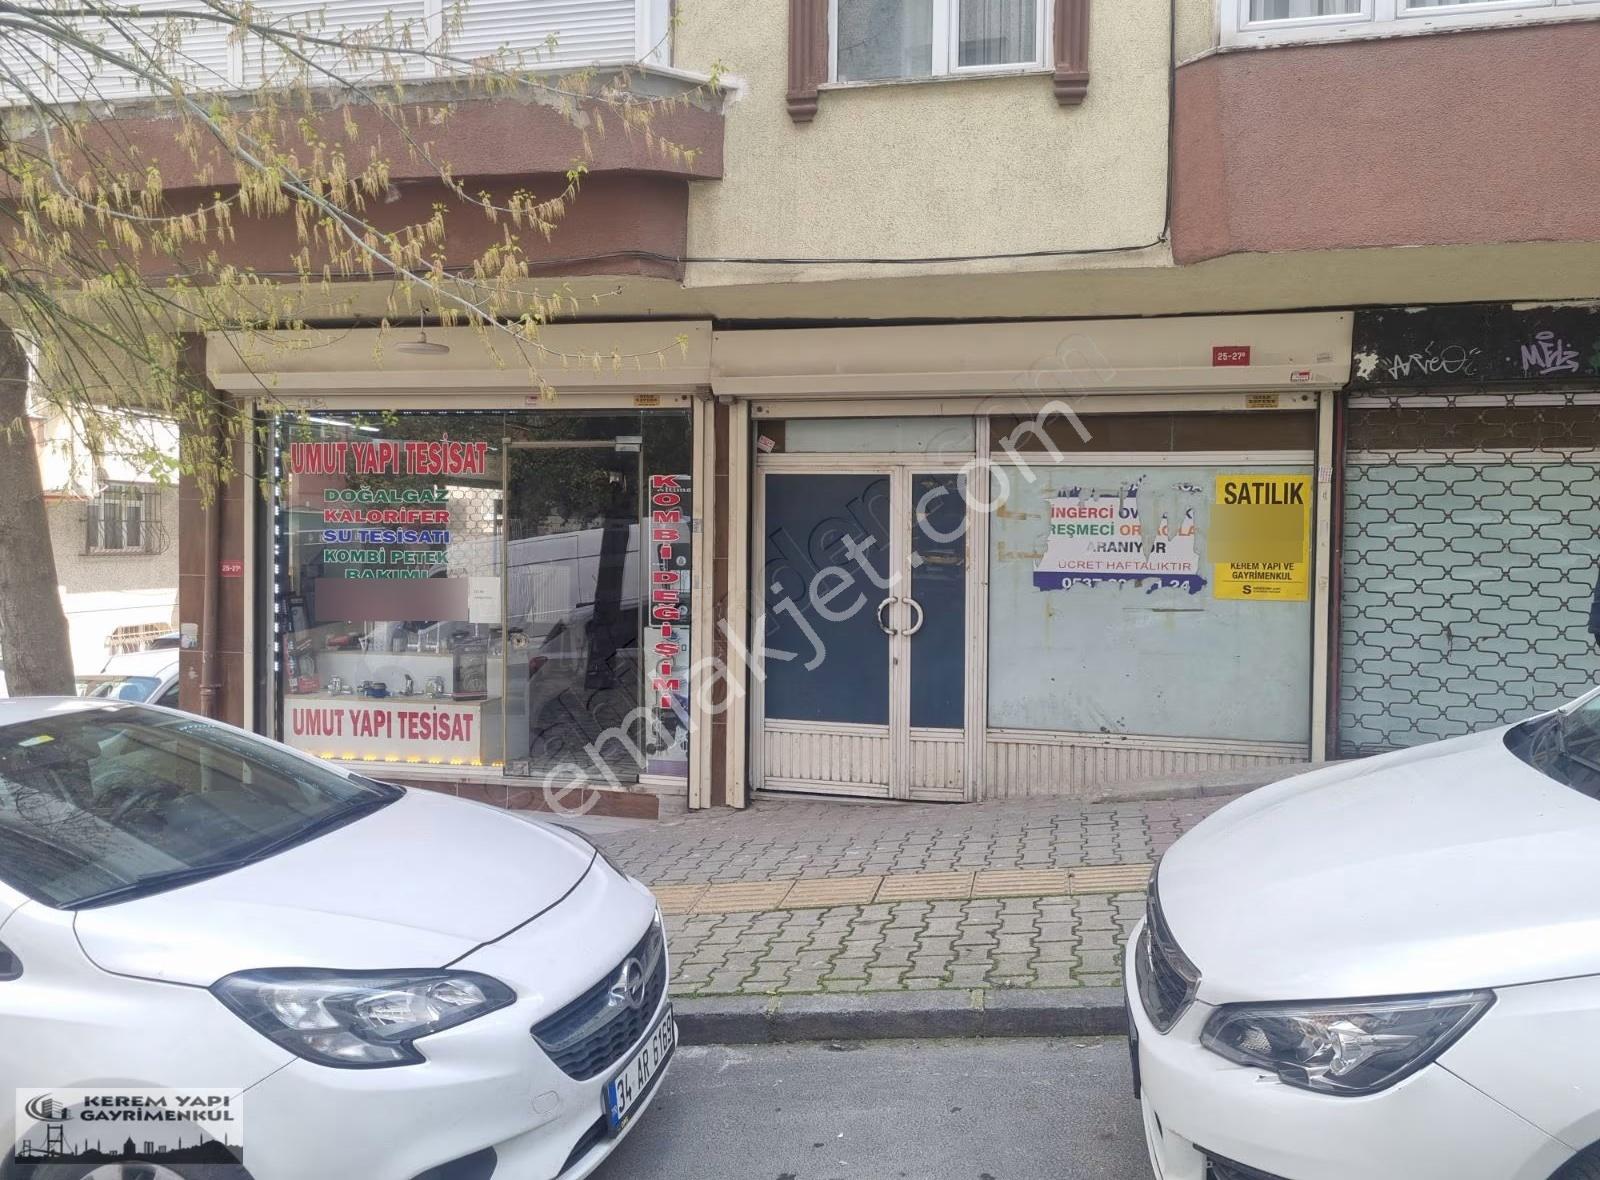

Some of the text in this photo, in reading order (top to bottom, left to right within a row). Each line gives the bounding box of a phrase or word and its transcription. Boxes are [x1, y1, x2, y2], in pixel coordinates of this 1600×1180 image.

[291, 434, 488, 475] UMUT YAPI TESİSAT
[324, 485, 450, 504] DOĞALGAZ
[1224, 482, 1304, 505] SATILIK
[324, 506, 450, 524] KALORİFER
[653, 475, 681, 559] KOMBİ
[323, 527, 450, 545] SU TESİSATI
[324, 547, 449, 565] KOMBİ PETEK
[345, 568, 429, 578] BAKIMI
[1106, 561, 1192, 571] HAFTALIKTIR
[1230, 562, 1295, 571] KEREM YAPI VE
[1232, 571, 1292, 581] GAYRİMENKUL
[292, 705, 474, 742] UMUT YAPI TESİSAT
[617, 1073, 633, 1114] 34
[637, 1048, 650, 1090] AR
